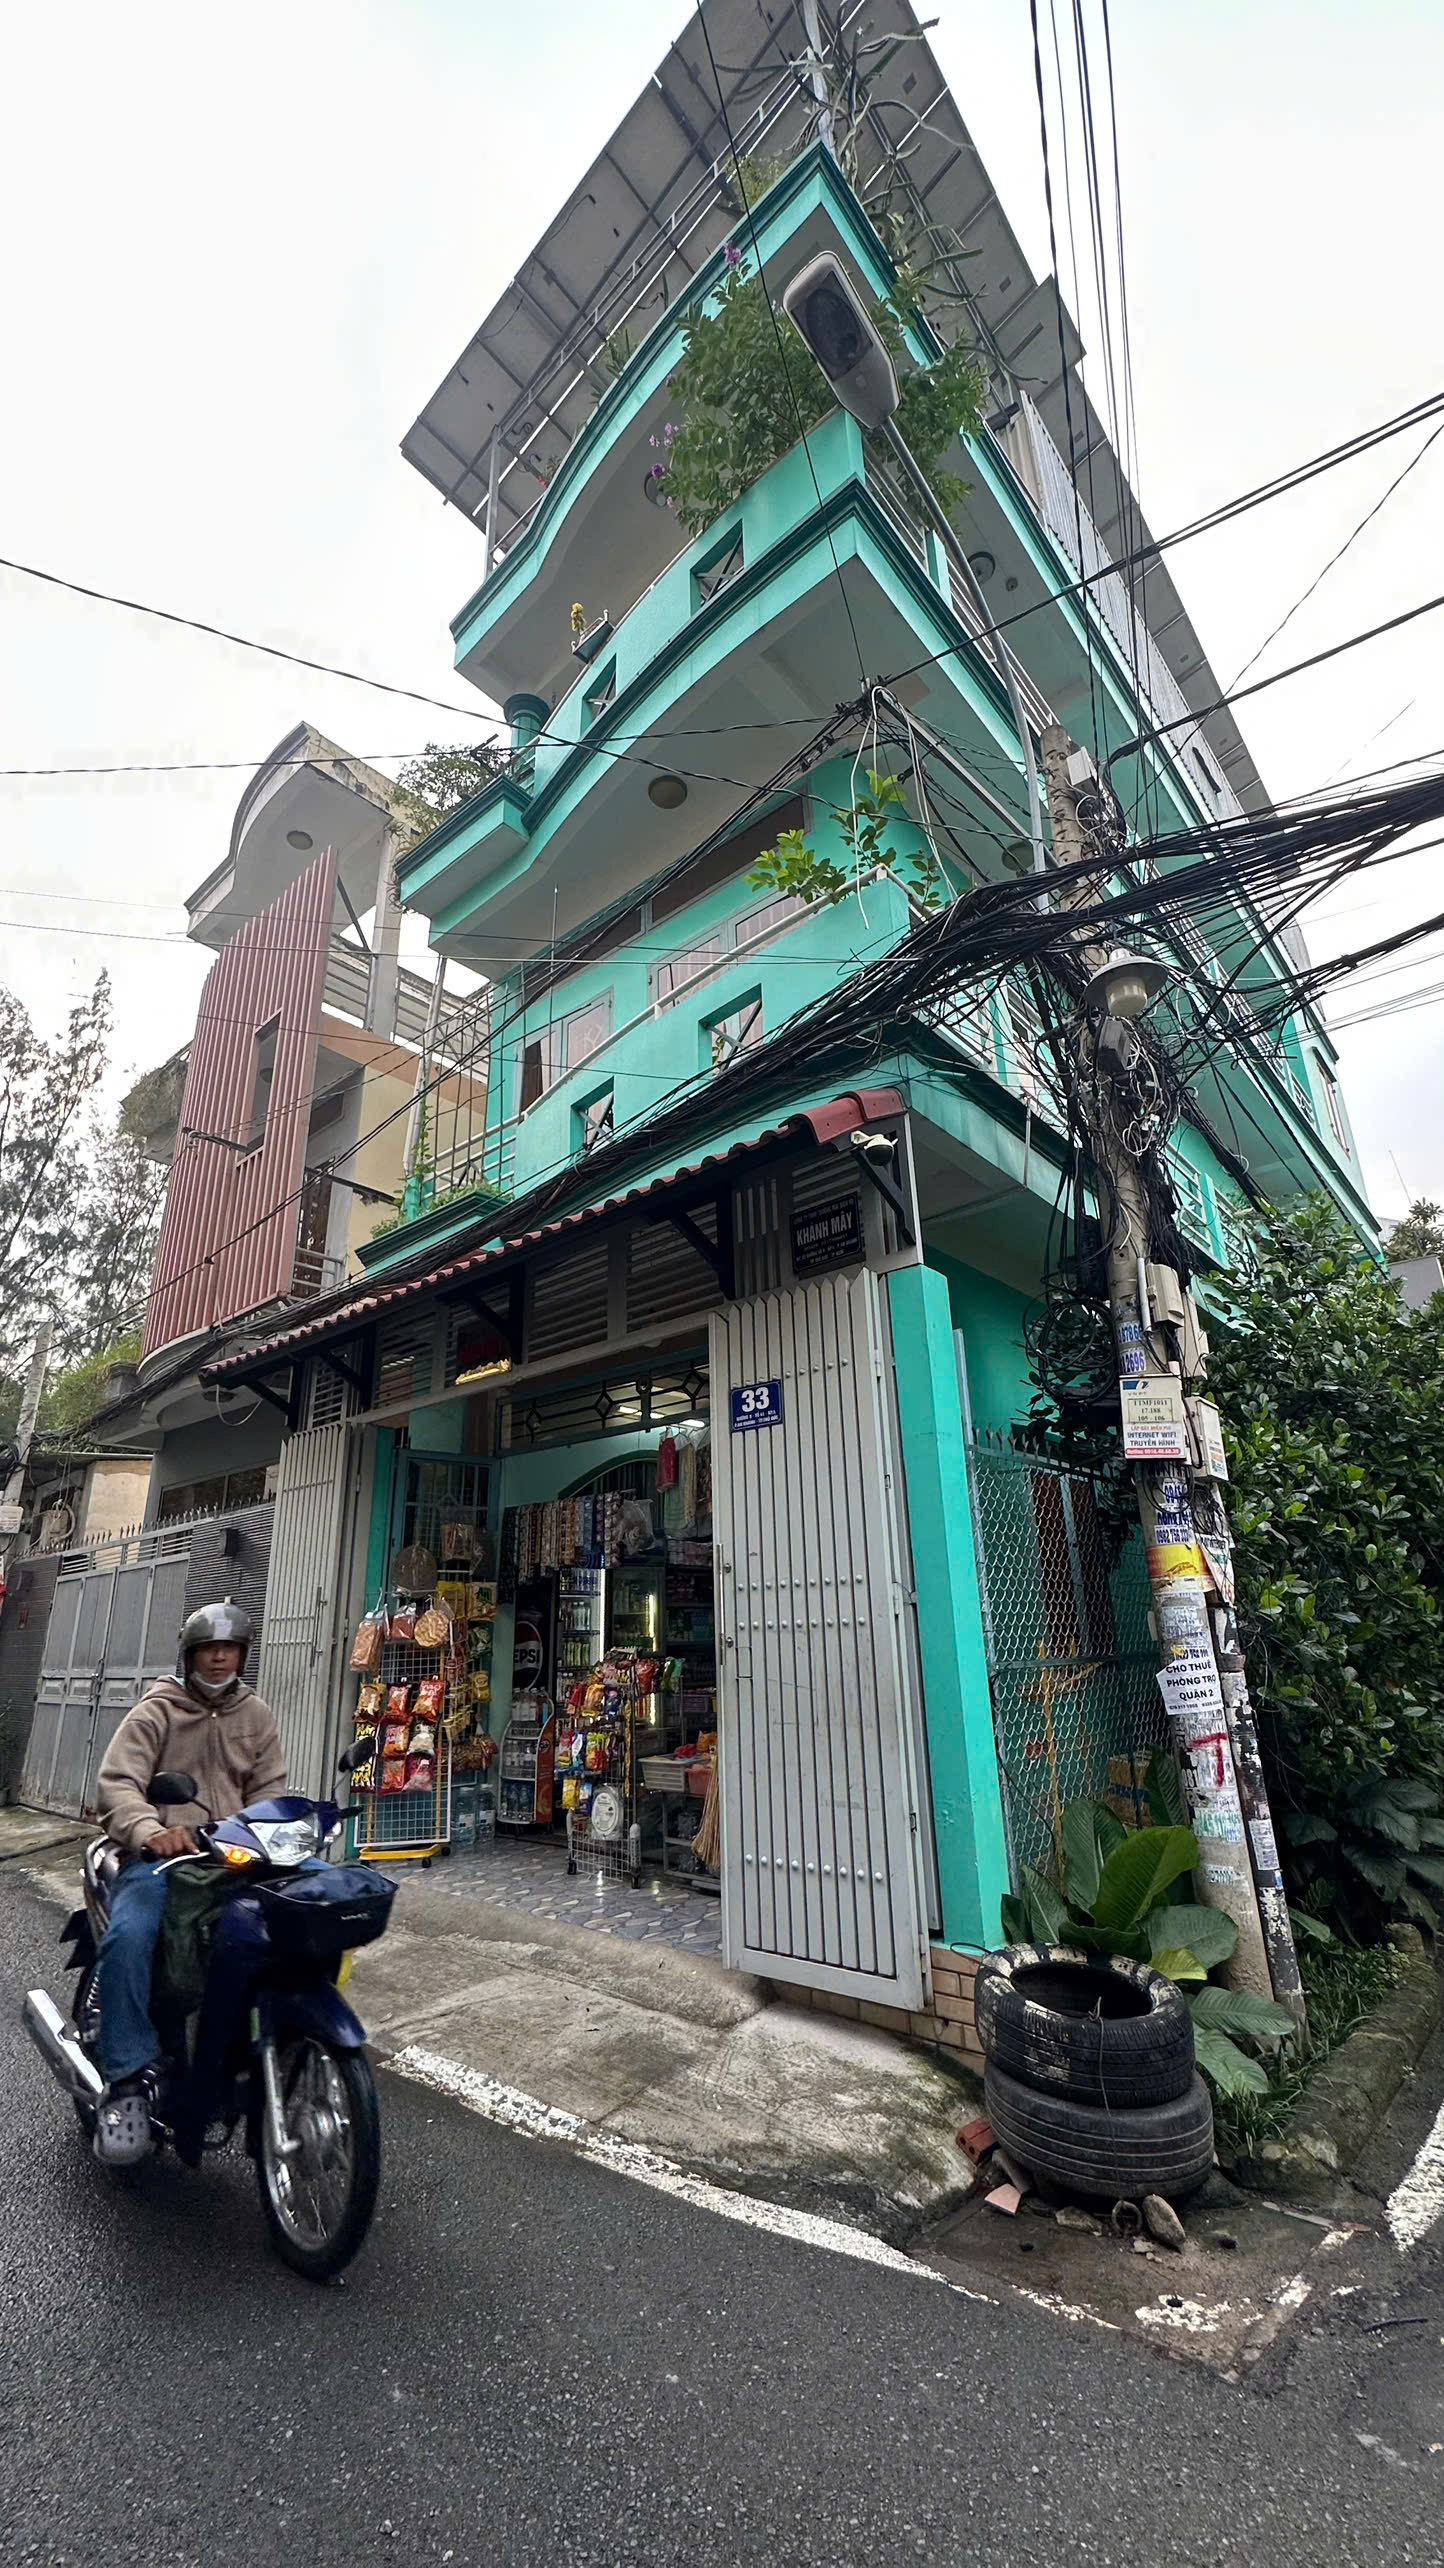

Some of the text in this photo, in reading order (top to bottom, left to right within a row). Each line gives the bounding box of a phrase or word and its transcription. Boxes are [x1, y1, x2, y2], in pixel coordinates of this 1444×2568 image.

[830, 1210, 852, 1235] MÂY
[741, 1386, 770, 1413] 33
[513, 1648, 541, 1665] EPSI
[1166, 1659, 1212, 1674] CHO THUÊ
[1166, 1675, 1201, 1688] PHÒNG
[1179, 1688, 1208, 1702] QUẬN
[1208, 1689, 1214, 1697] 2
